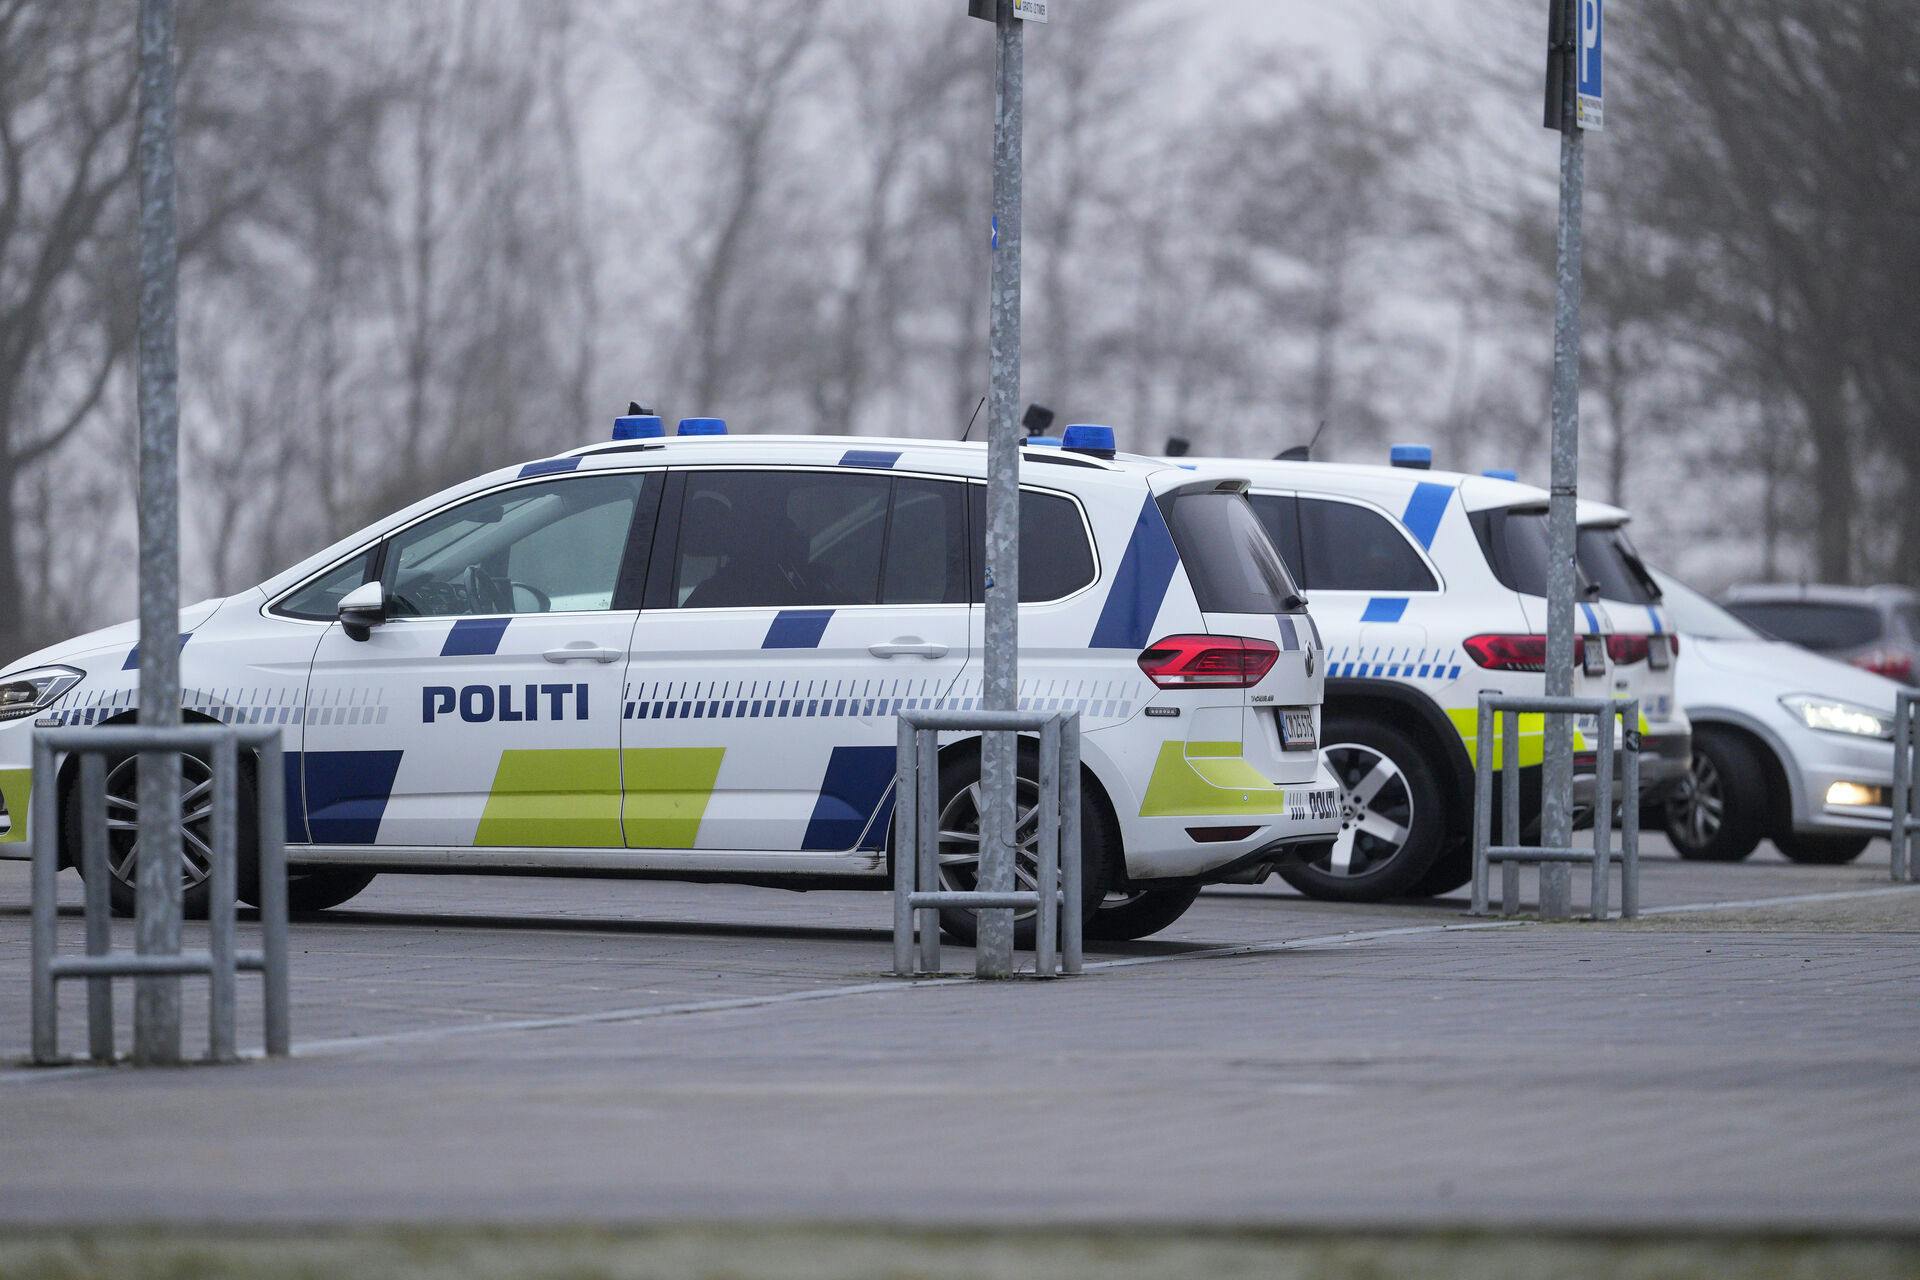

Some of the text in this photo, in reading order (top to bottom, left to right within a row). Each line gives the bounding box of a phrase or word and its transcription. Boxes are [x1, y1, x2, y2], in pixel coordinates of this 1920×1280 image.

[1582, 0, 1598, 83] P
[423, 683, 589, 723] POLITI
[1309, 790, 1338, 820] POLITI
